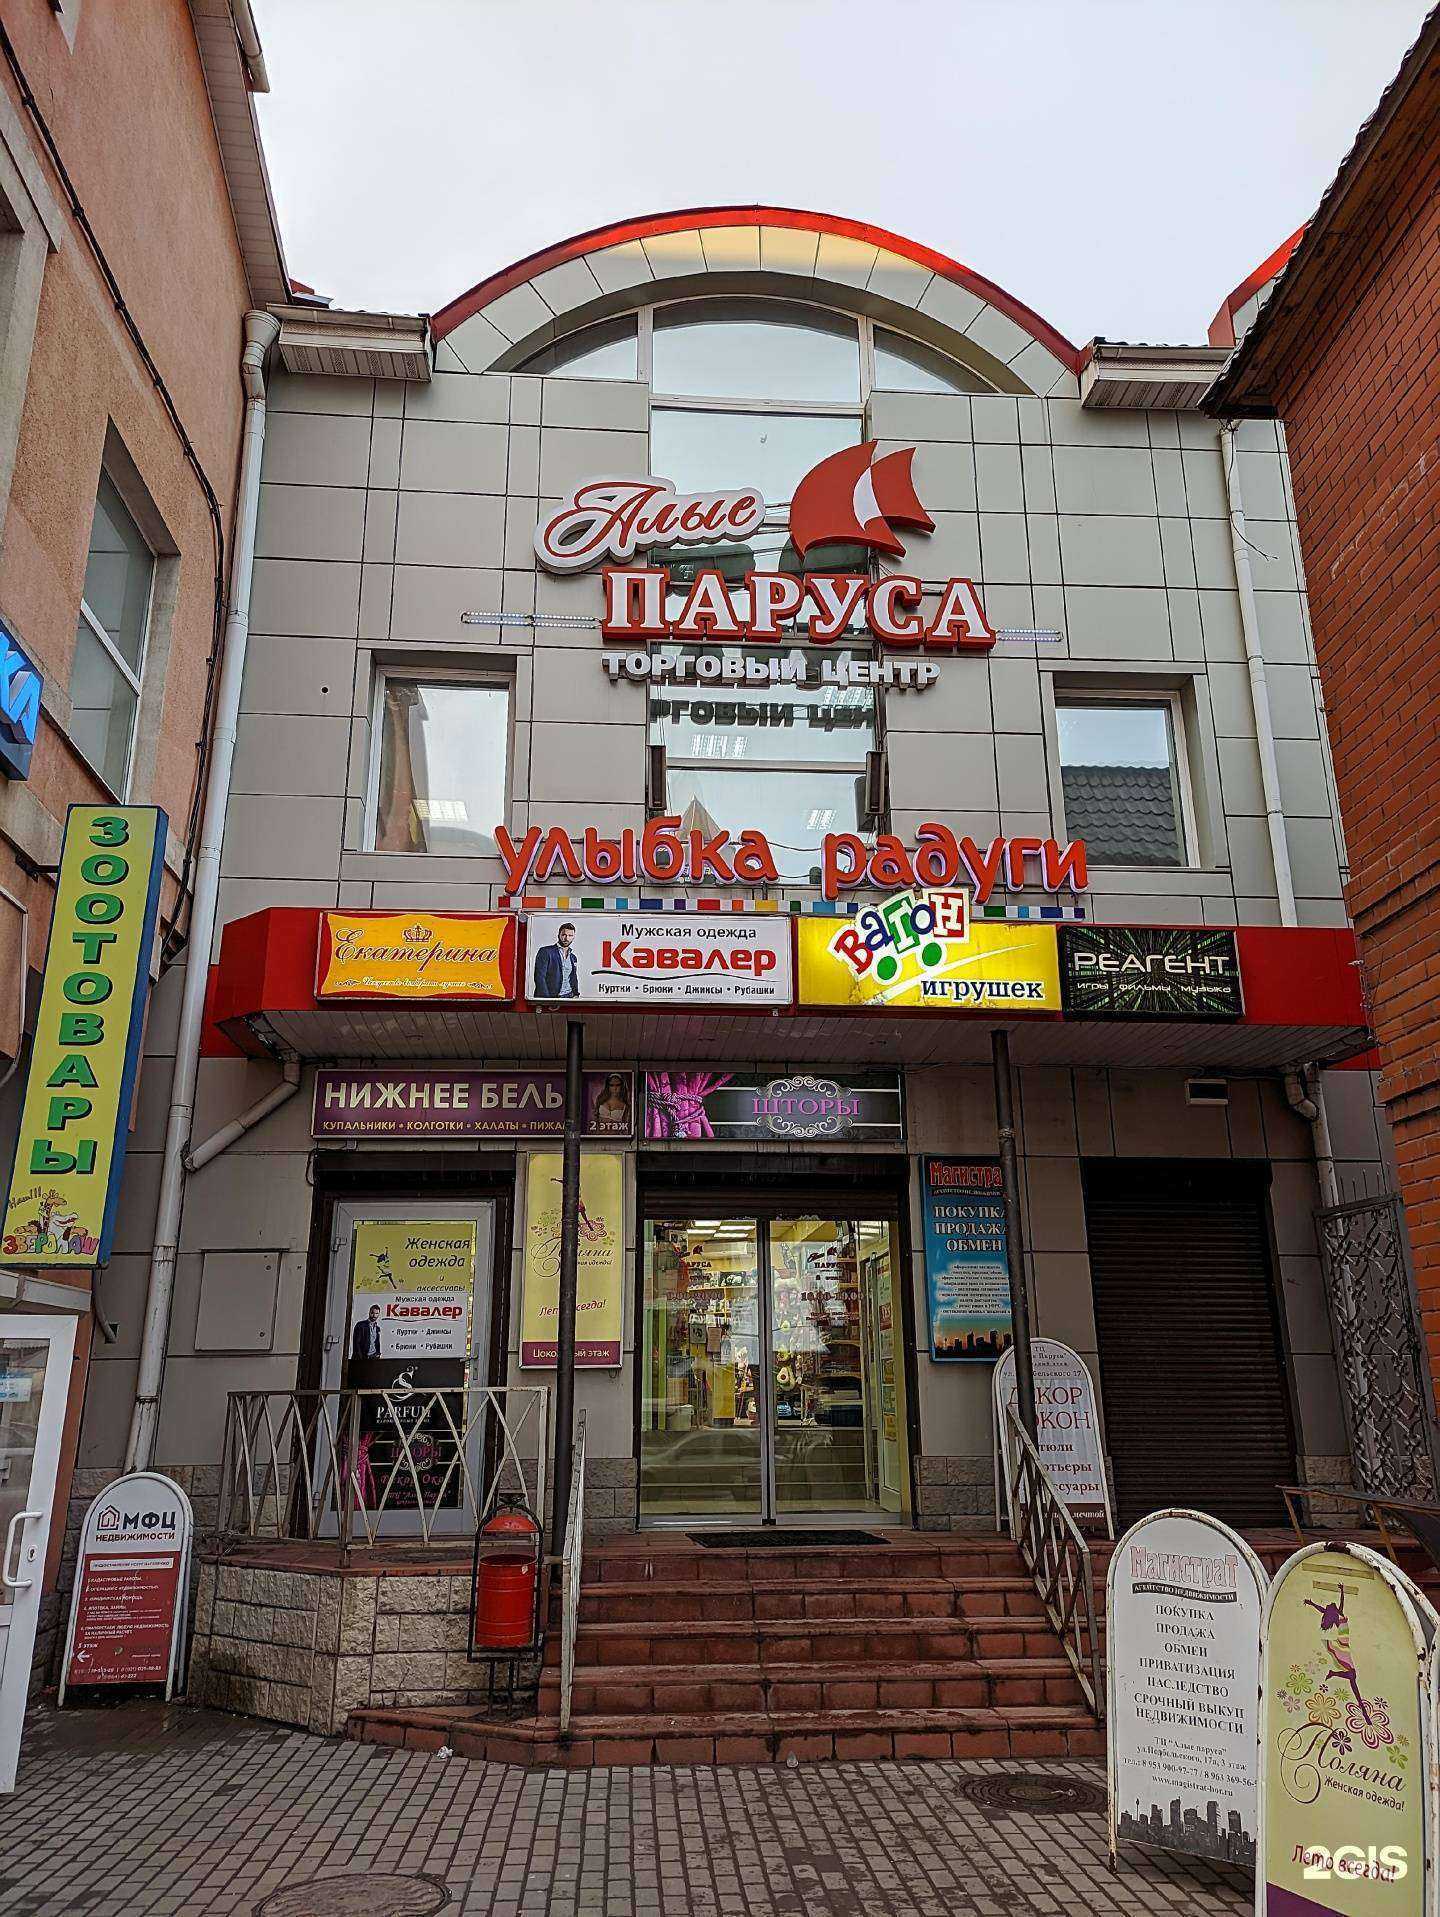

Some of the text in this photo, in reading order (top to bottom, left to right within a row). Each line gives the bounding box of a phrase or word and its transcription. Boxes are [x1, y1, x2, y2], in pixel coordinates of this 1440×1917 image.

[543, 481, 757, 560] Алые
[603, 566, 997, 648] ПАРУСА
[601, 651, 942, 689] ТОРГОВЫЙ ЦЕНТР
[493, 815, 1089, 905] улыбка радуги
[621, 924, 757, 939] Мужская одежда
[335, 928, 497, 973] Екатерина
[602, 940, 777, 976] Кавалер
[1073, 952, 1230, 974] РЕАГЕНТ
[30, 816, 130, 1176] ЗООТОВАРЫ
[598, 984, 775, 995] Куртки Брюки Джинсы Рубашки
[921, 980, 1044, 1001] игрушек
[324, 1082, 564, 1110] НИЖНЕЕ БЕЛЬ
[752, 1098, 861, 1115] ШТОРЫ
[322, 1121, 629, 1131] КУПАЛЬНИКИ КОЛГОТКИ ХАЛАТЫ ПИЖА 2 этаж
[930, 1161, 1004, 1187] Магистра
[935, 1222, 1006, 1237] ПРОДАЖ
[405, 1237, 471, 1250] Женская
[946, 1239, 1002, 1251] ОБМЕН
[408, 1254, 466, 1268] одежда
[386, 1304, 463, 1319] Кавалер
[576, 1299, 607, 1311] сегда!
[588, 1349, 610, 1357] этаж
[1008, 1386, 1083, 1405] ДКОР
[123, 1511, 176, 1530] МФЦ
[95, 1532, 175, 1542] НЕДВИЖИМОСТИ
[1130, 1545, 1239, 1589] Магистрат
[1133, 1584, 1235, 1601] АГЕНТСТВО НЕДВИЖИМОСТИ
[1156, 1604, 1215, 1621] ПОКУПКА
[1156, 1622, 1216, 1640] ПРОДАЖА
[1164, 1642, 1208, 1657] ОБМЕН
[1139, 1657, 1236, 1680] ПРИВАТИЗАЦИЯ
[1147, 1676, 1229, 1698] НАСЛЕДСТВО
[1134, 1692, 1245, 1719] СРОЧНЫЙ ВЫКУП
[1136, 1706, 1245, 1735] НЕДВИЖИМОСТИ
[1142, 1760, 1147, 1768] 8
[1204, 1771, 1209, 1779] 8
[1277, 1722, 1407, 1805] Поляна
[1323, 1776, 1406, 1813] Женская одежда!
